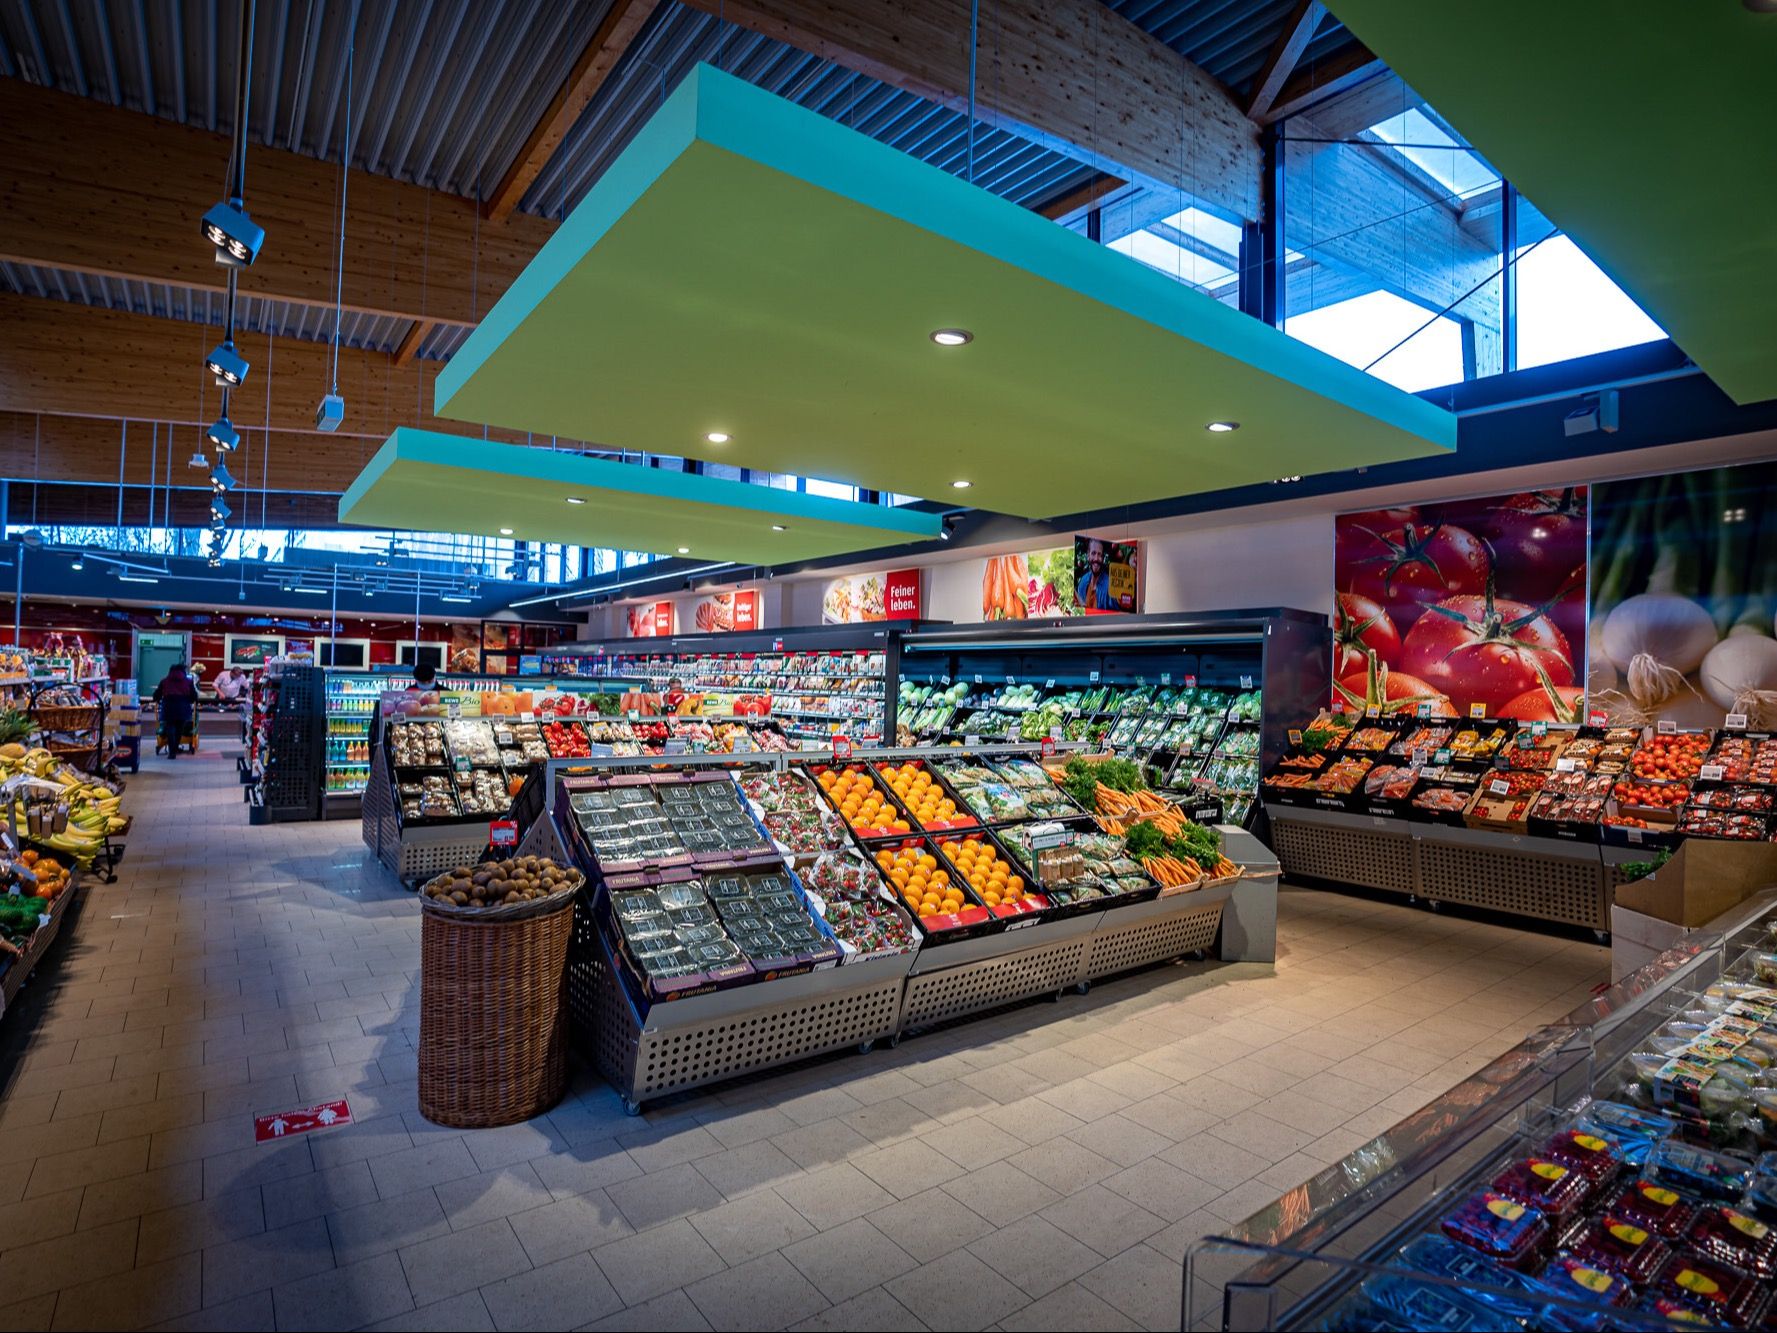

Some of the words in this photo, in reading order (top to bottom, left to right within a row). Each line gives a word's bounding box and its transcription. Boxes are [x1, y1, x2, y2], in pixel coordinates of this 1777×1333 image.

[890, 585, 916, 598] Feiner
[890, 599, 916, 611] leben.
[612, 876, 640, 885] FRUTANIA
[778, 966, 810, 978] FRUTANIA
[681, 984, 718, 998] FRUTANIA
